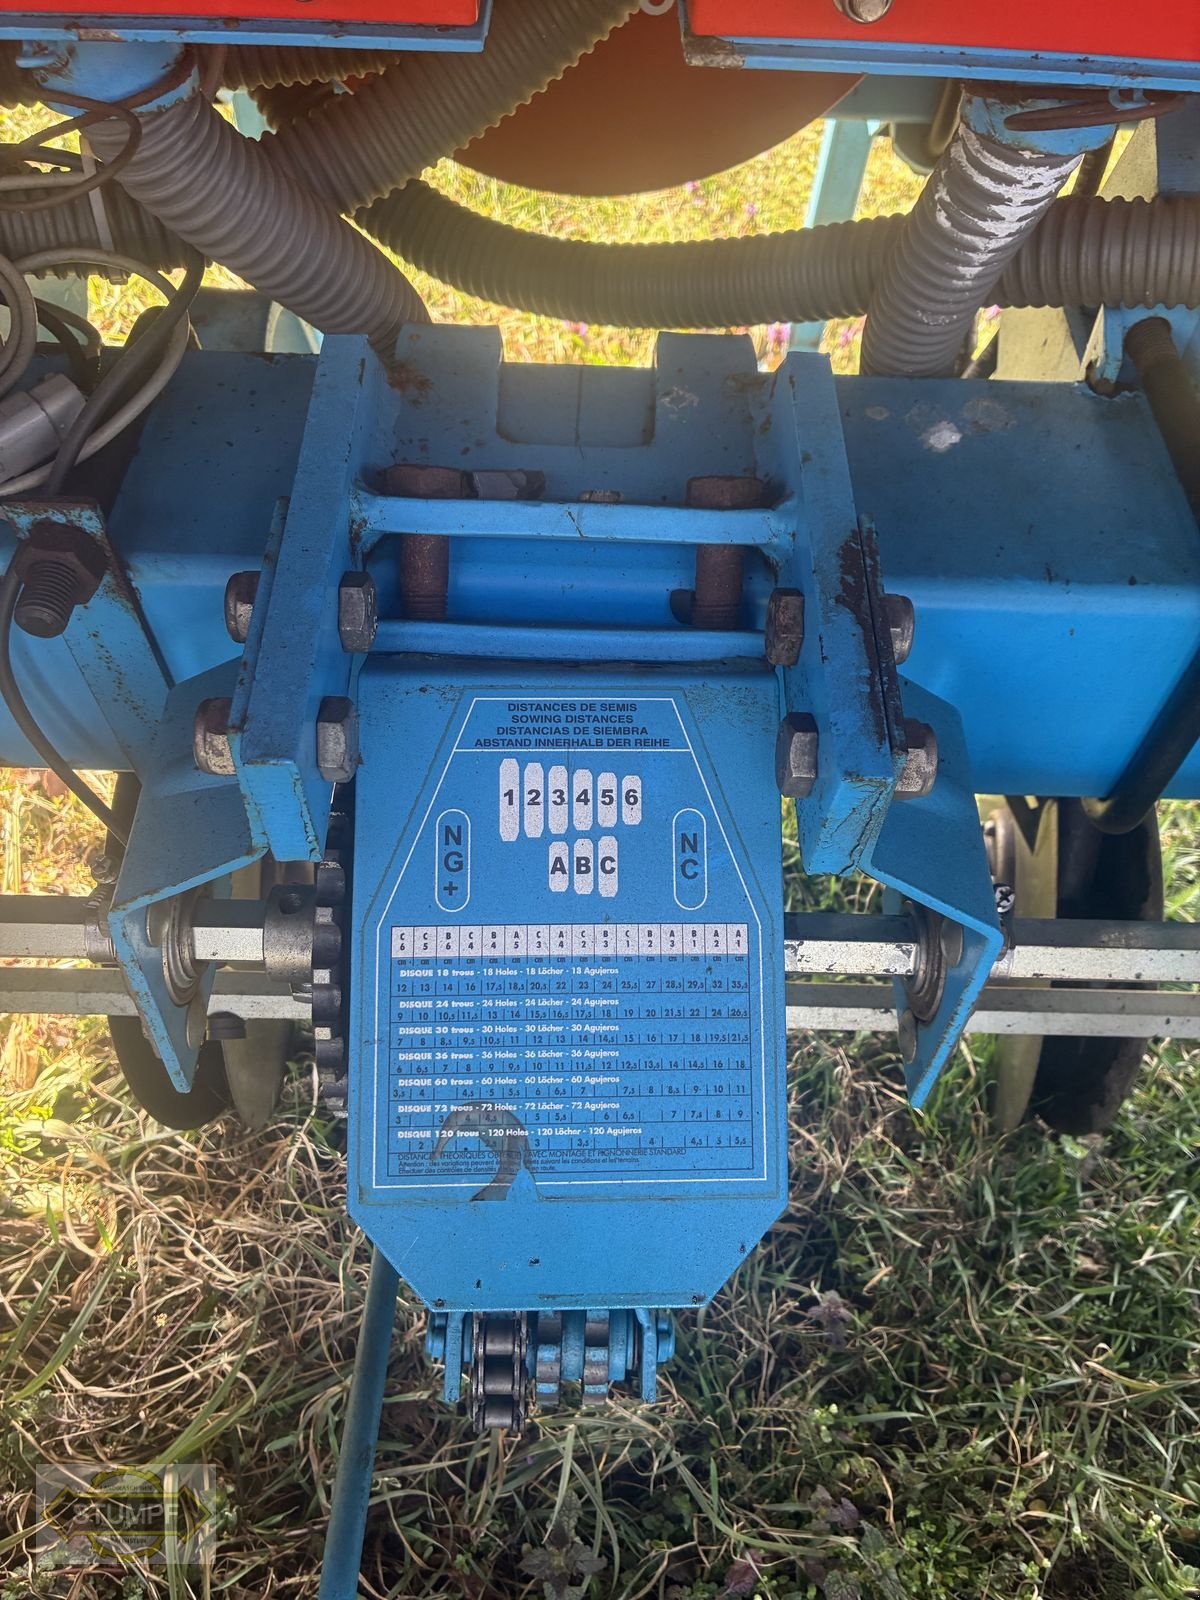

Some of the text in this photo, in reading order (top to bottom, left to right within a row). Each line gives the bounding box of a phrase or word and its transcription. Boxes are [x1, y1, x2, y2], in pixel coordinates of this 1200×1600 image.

[508, 704, 576, 712] DISTANCES
[600, 704, 637, 712] SEMIS
[512, 715, 633, 723] SOWING DISTANCES
[497, 727, 648, 735] DISTANCIAS DE SIEMBRA
[475, 739, 531, 747] ABSTAND
[535, 739, 603, 747] INNERHALB
[504, 789, 638, 805] 1 2 3 4 5 6
[550, 856, 615, 874] A B C
[584, 967, 618, 976] Agujeros
[584, 999, 618, 1007] Agujeros
[584, 1024, 619, 1033] Agujeros
[584, 1050, 619, 1058] Agujeros
[584, 1076, 619, 1084] Agujeros
[495, 1103, 517, 1111] Holes
[584, 1102, 620, 1111] Agujeros
[555, 1127, 580, 1135] Löcher
[607, 1127, 641, 1136] Agujeros
